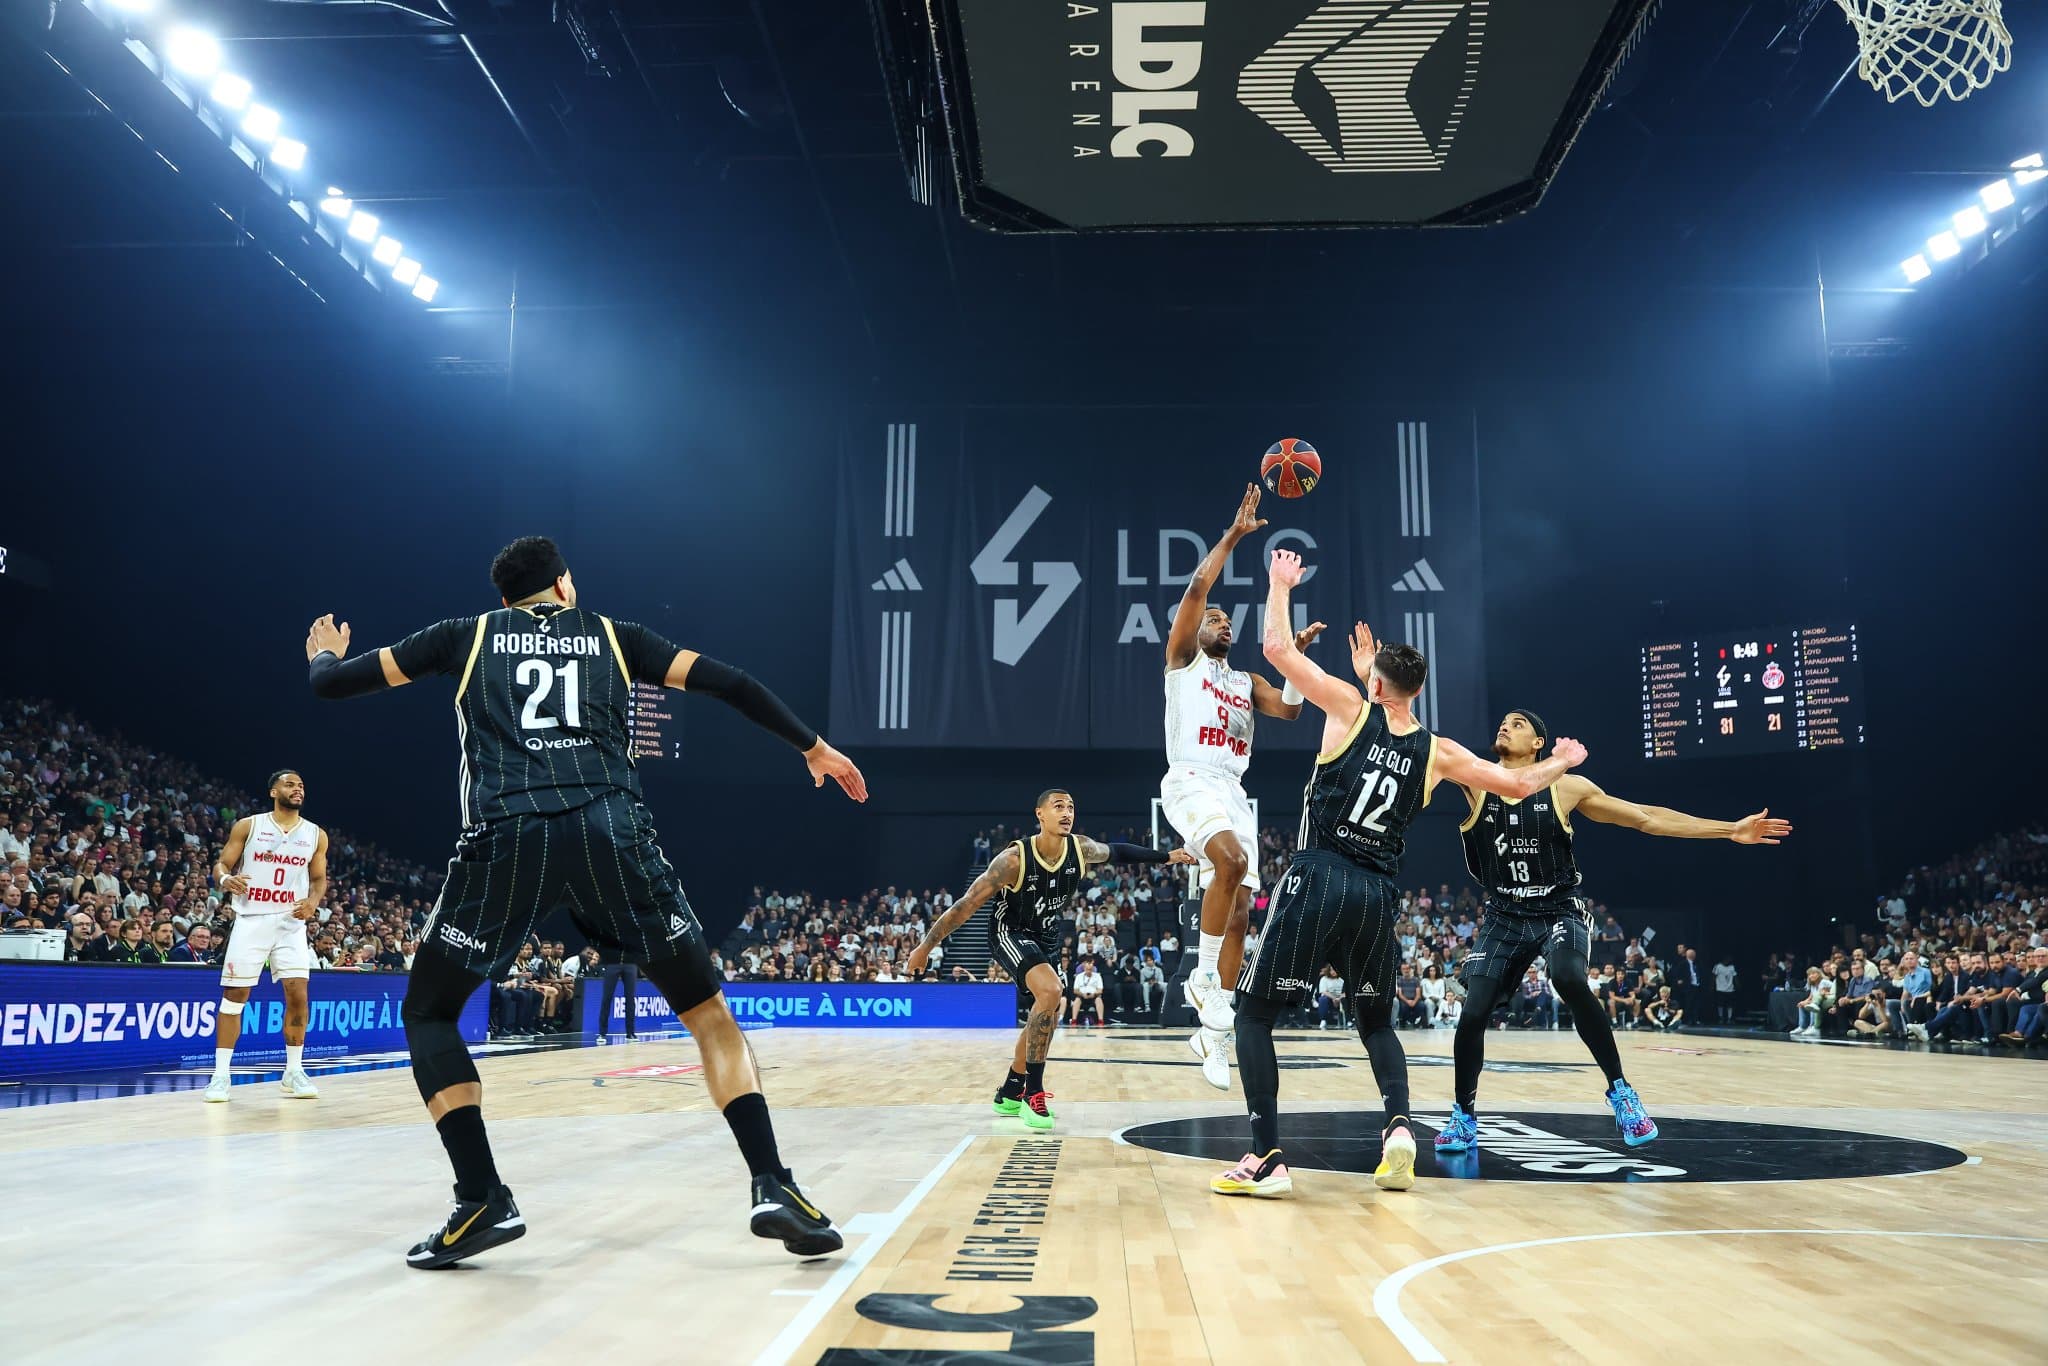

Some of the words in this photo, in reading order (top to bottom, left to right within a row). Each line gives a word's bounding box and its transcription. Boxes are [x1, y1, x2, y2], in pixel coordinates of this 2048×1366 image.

[1067, 2, 1101, 158] ARENA
[1110, 1, 1207, 158] LDLC
[1117, 528, 1318, 586] LDLC
[1802, 627, 1826, 636] OKOBO
[493, 633, 600, 656] ROBERSON
[1803, 648, 1821, 656] LOYD
[1744, 673, 1751, 683] 2
[1805, 667, 1830, 676] DIALLO
[515, 658, 581, 730] 21
[1767, 713, 1781, 731] 21
[544, 736, 593, 749] VEOLIA
[1367, 743, 1387, 766] DE
[1348, 769, 1398, 833] 12
[1350, 831, 1380, 847] VEOLIA
[1510, 838, 1538, 847] LDLC
[274, 868, 285, 886] 0
[1508, 860, 1530, 884] 13
[1286, 875, 1301, 895] 12
[440, 922, 487, 953] REPAM
[1276, 978, 1313, 993] REPAM
[613, 996, 671, 1019] REDEZ-VOUS
[818, 992, 834, 1017] À
[854, 998, 912, 1017] LYON
[241, 1001, 261, 1035] N
[266, 1000, 374, 1038] BUTIQUE
[992, 1139, 1063, 1189] EXPERIENCE
[945, 1193, 1050, 1282] HIGH-TECH
